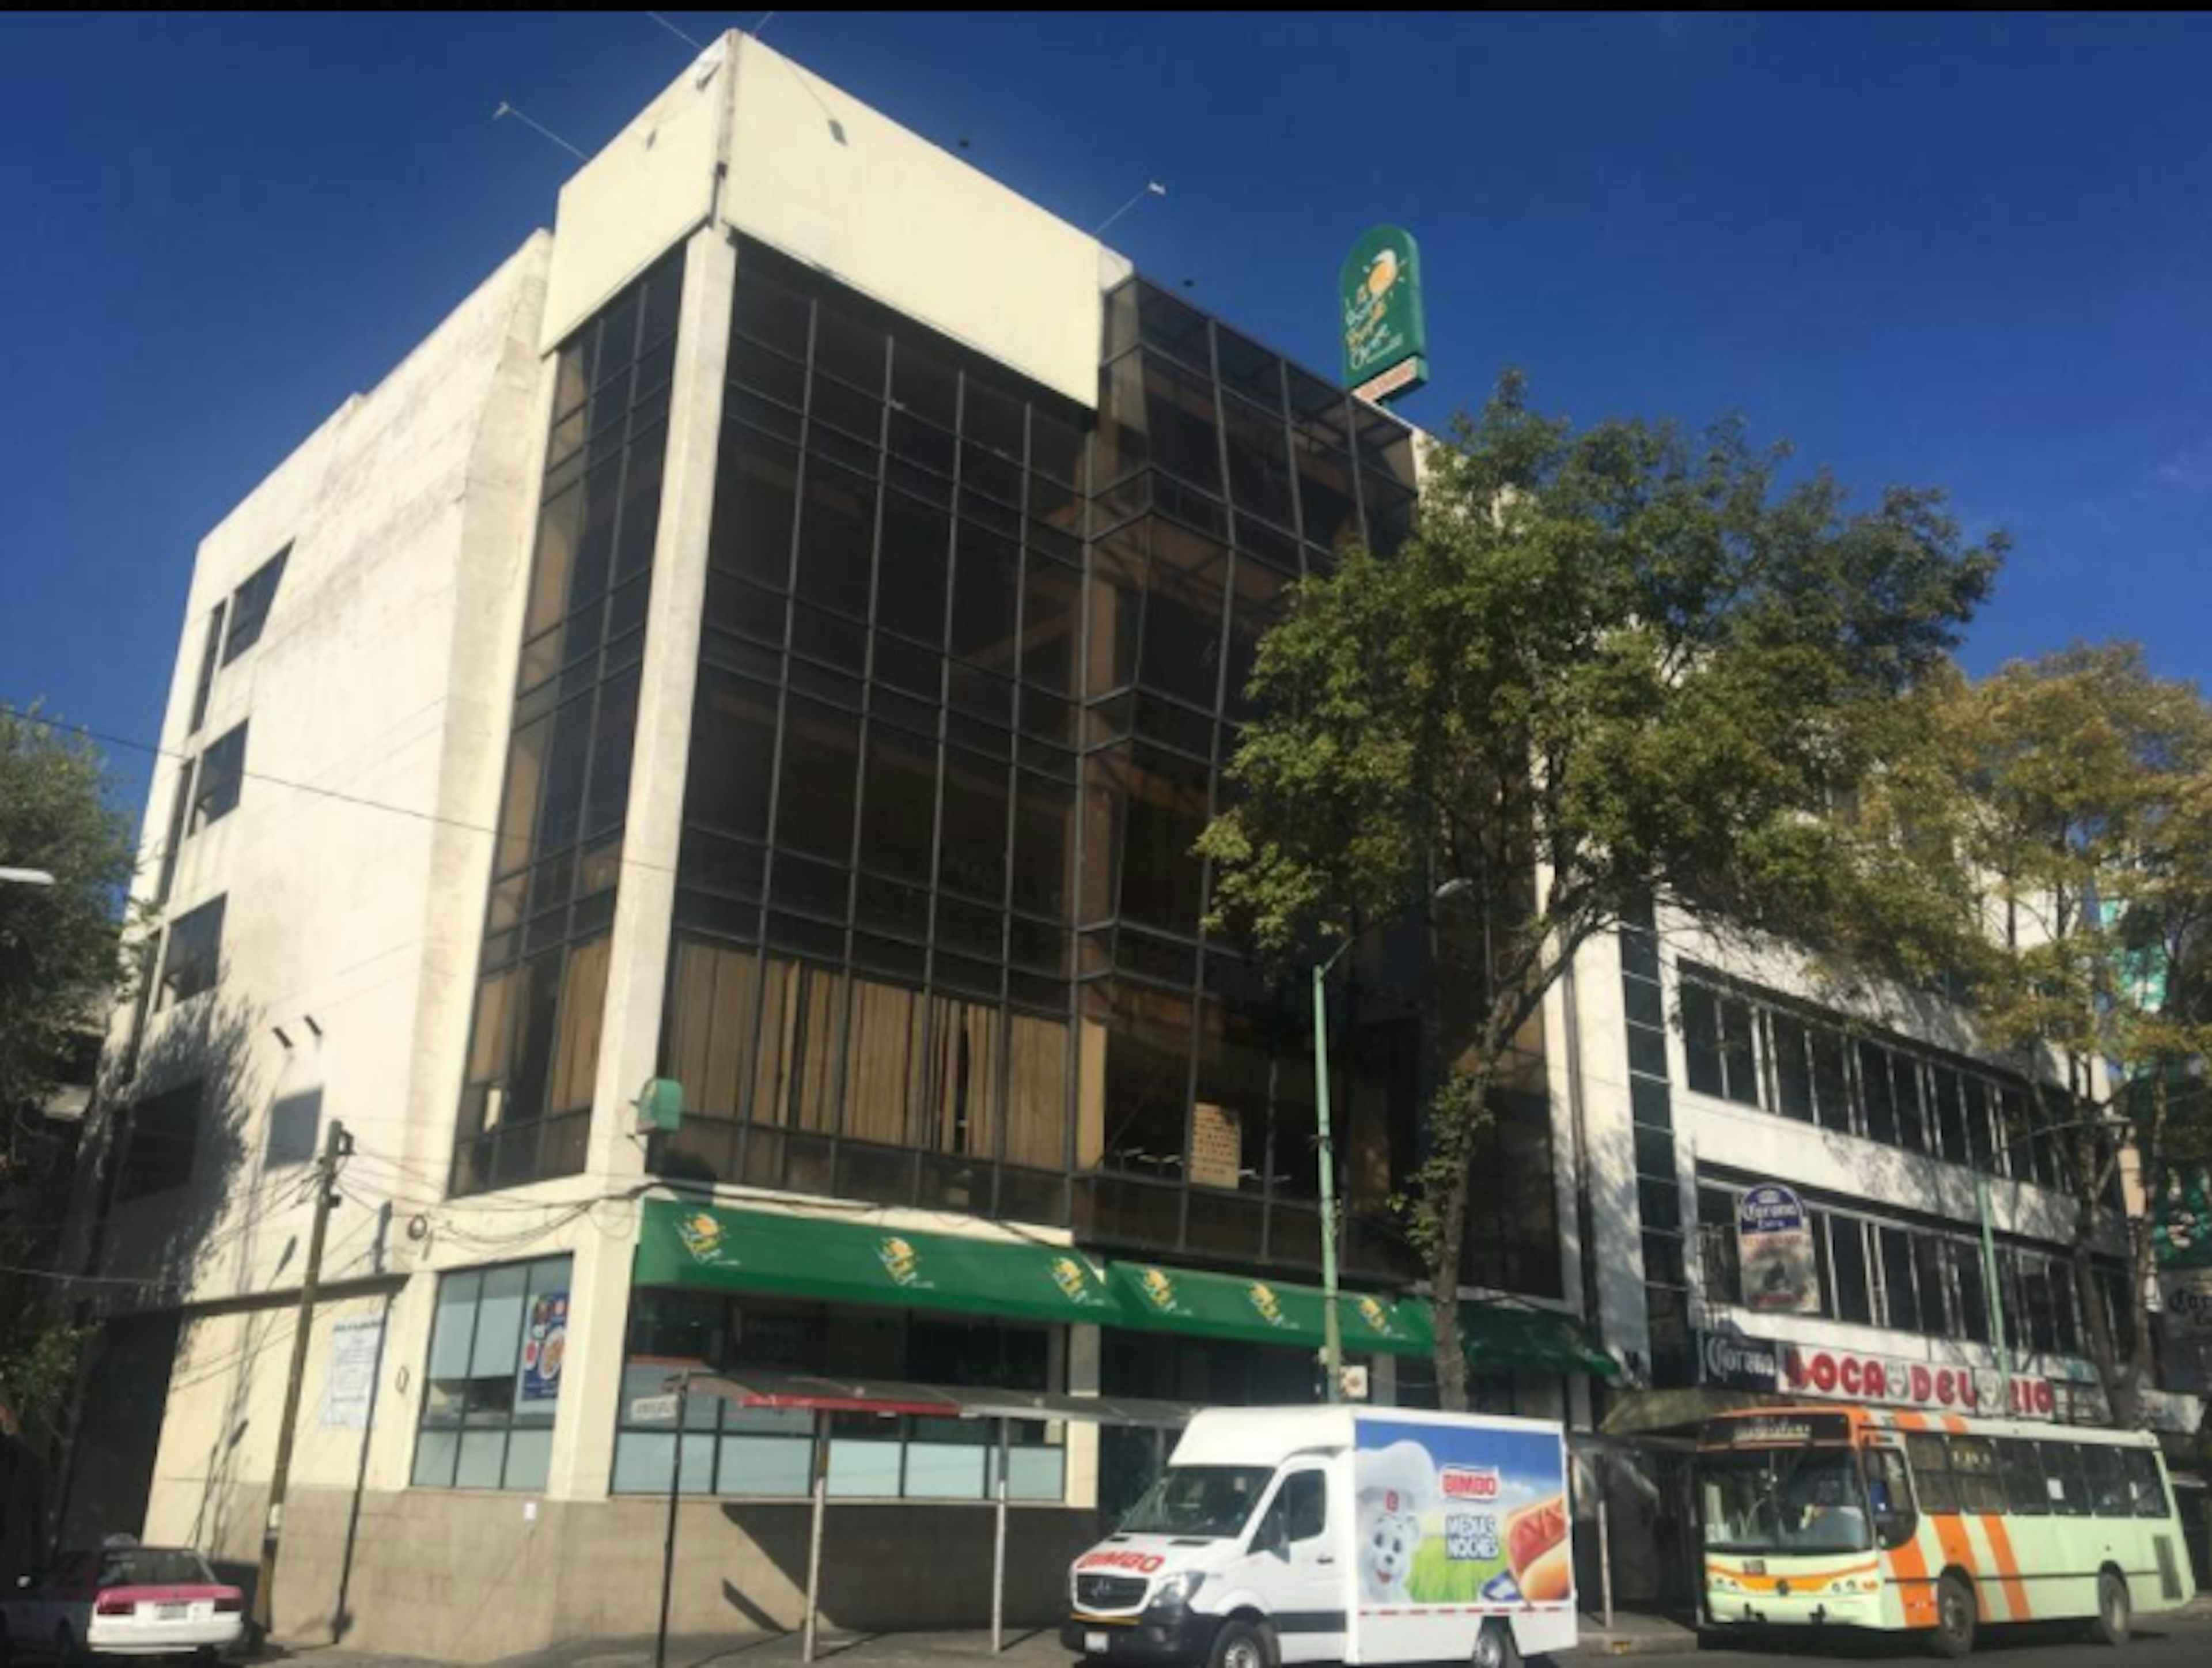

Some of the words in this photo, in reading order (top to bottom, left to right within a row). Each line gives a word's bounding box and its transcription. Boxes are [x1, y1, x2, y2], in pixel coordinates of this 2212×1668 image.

[1706, 1336, 1775, 1382] Corona
[1442, 1474, 1495, 1497] BIMBO
[1446, 1514, 1496, 1535] MEDIAS
[1446, 1535, 1499, 1558] NOCHES
[1076, 1551, 1165, 1574] BIMBO
